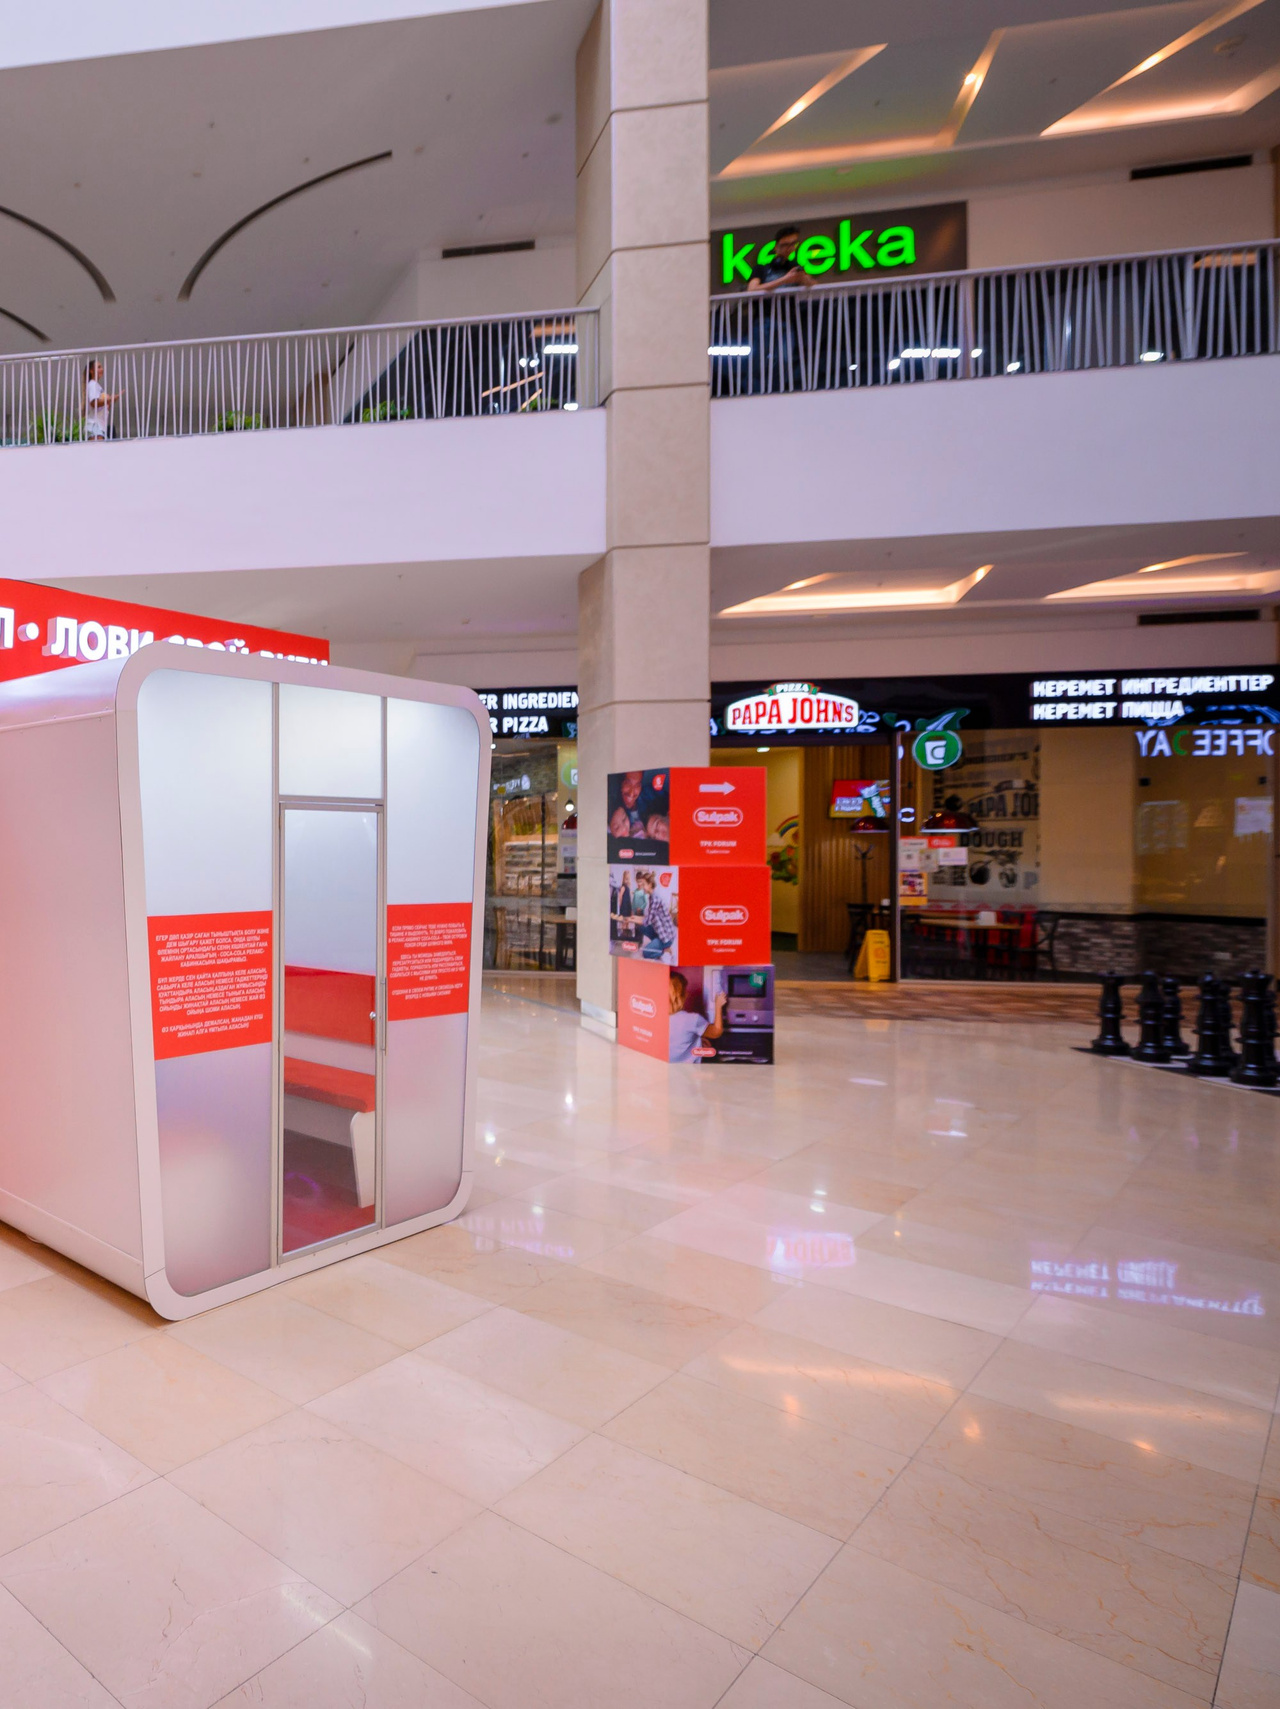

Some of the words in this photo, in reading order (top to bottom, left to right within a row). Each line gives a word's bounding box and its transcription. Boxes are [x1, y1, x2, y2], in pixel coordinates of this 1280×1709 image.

[775, 683, 809, 693] PIZZA
[1121, 675, 1274, 696] ИНГРЕДИЕНТТЕР
[503, 692, 578, 710] INGREDIEN
[731, 698, 783, 726] PAPA
[787, 697, 854, 725] JOHNS
[1121, 700, 1186, 720] ПИЦЦА
[503, 716, 548, 733] PIZZA
[697, 810, 738, 825] Sulpak
[705, 909, 744, 923] Sulpak
